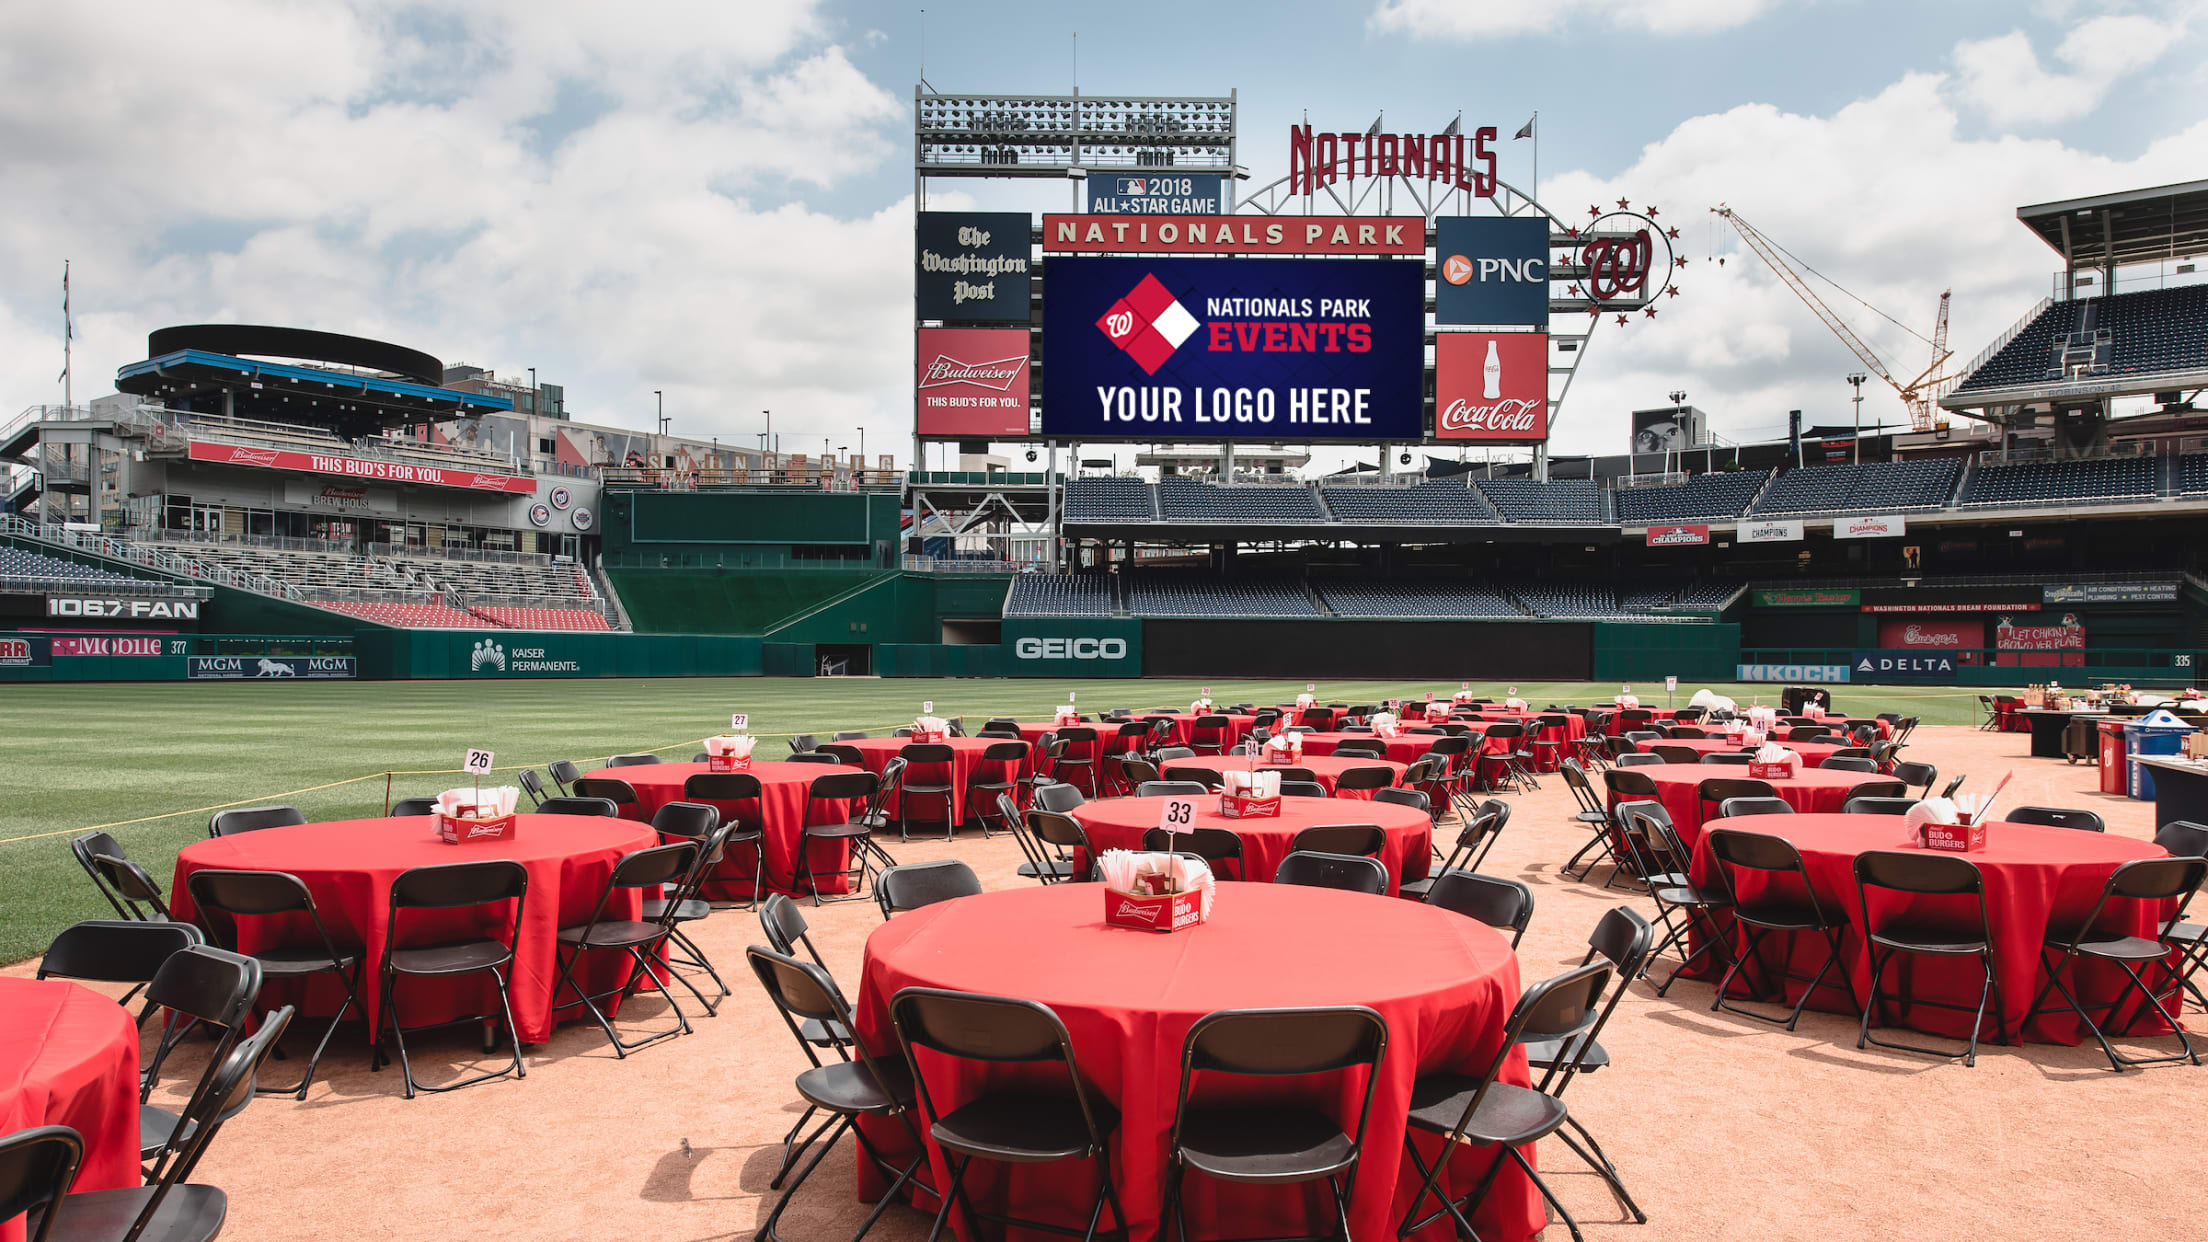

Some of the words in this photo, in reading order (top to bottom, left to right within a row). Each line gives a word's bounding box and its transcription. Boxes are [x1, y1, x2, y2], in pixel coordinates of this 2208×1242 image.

[1290, 124, 1497, 198] NATIONALS
[1149, 178, 1192, 196] 2018
[1171, 199, 1216, 214] GAME
[957, 225, 990, 247] The
[1057, 222, 1283, 245] NATIONALS
[1307, 224, 1405, 246] PARK
[922, 249, 1028, 277] Washington
[1476, 257, 1545, 283] PNC
[953, 281, 996, 305] Post
[1207, 297, 1313, 318] NATIONALS
[1320, 298, 1372, 318] PARK
[1207, 321, 1372, 353] EVENTS
[930, 360, 1018, 381] Budweiser
[926, 396, 948, 408] THIS
[950, 396, 977, 408] BUD'S
[979, 396, 997, 408] FOR
[998, 396, 1021, 408] YOU.
[1097, 385, 1182, 423] YOUR
[1195, 387, 1275, 423] LOGO
[1290, 387, 1372, 424] HERE
[1442, 397, 1542, 431] Coca-Cola
[234, 449, 275, 462] Budweiser
[311, 455, 343, 472] THIS
[345, 457, 385, 478] BUD'S
[388, 465, 414, 480] FOR
[416, 467, 445, 484] YOU.
[1752, 528, 1788, 539] CHAMPIONS
[1849, 524, 1888, 534] CHAMPIONS
[1652, 536, 1704, 544] CHAMPIONS
[49, 598, 124, 617] 106.7
[131, 601, 197, 618] FAN
[2011, 629, 2031, 641] LET
[2054, 636, 2083, 649] PLATE
[170, 640, 187, 655] 377
[511, 647, 545, 660] KAISER
[1015, 637, 1127, 660] GEICO
[197, 658, 243, 671] MGM
[308, 658, 348, 671] MGM
[511, 660, 578, 673] PERMANENTE
[1880, 658, 1952, 672] DELTA
[2174, 655, 2191, 667] 335
[1766, 665, 1842, 682] KOCH
[735, 715, 746, 725] 27
[1756, 720, 1766, 731] 41
[1247, 742, 1257, 756] 34
[470, 752, 489, 768] 26
[1167, 801, 1191, 824] 33
[1928, 830, 1944, 839] BUD
[1928, 838, 1966, 849] BURGERS
[1174, 911, 1199, 927] BURGERS
